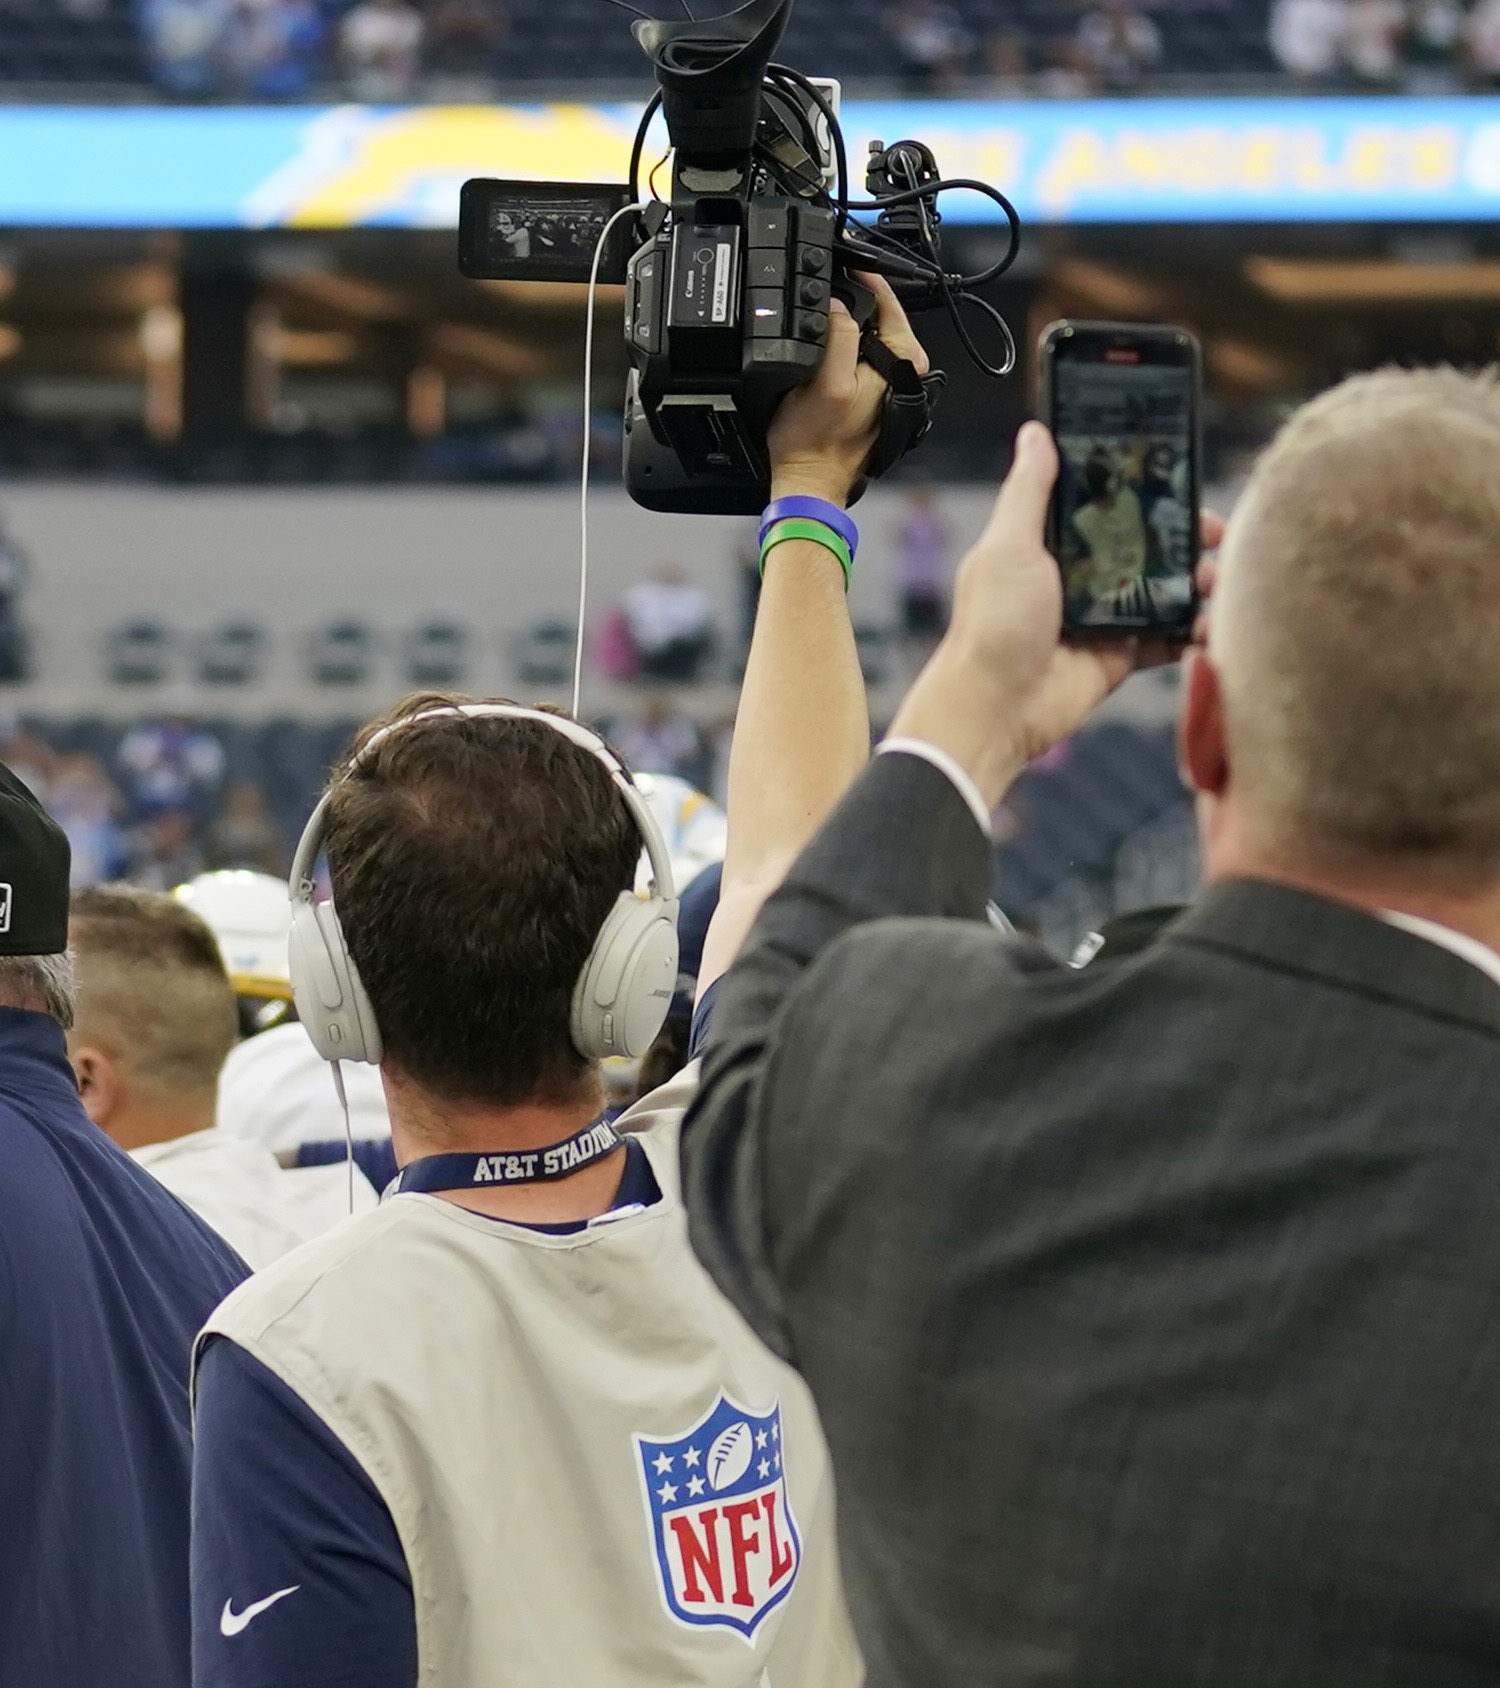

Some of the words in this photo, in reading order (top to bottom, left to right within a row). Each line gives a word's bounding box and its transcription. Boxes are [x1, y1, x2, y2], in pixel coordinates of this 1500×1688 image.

[473, 1154, 538, 1182] AT&T
[544, 1119, 619, 1175] STADIUM
[669, 1490, 794, 1608] NFL
